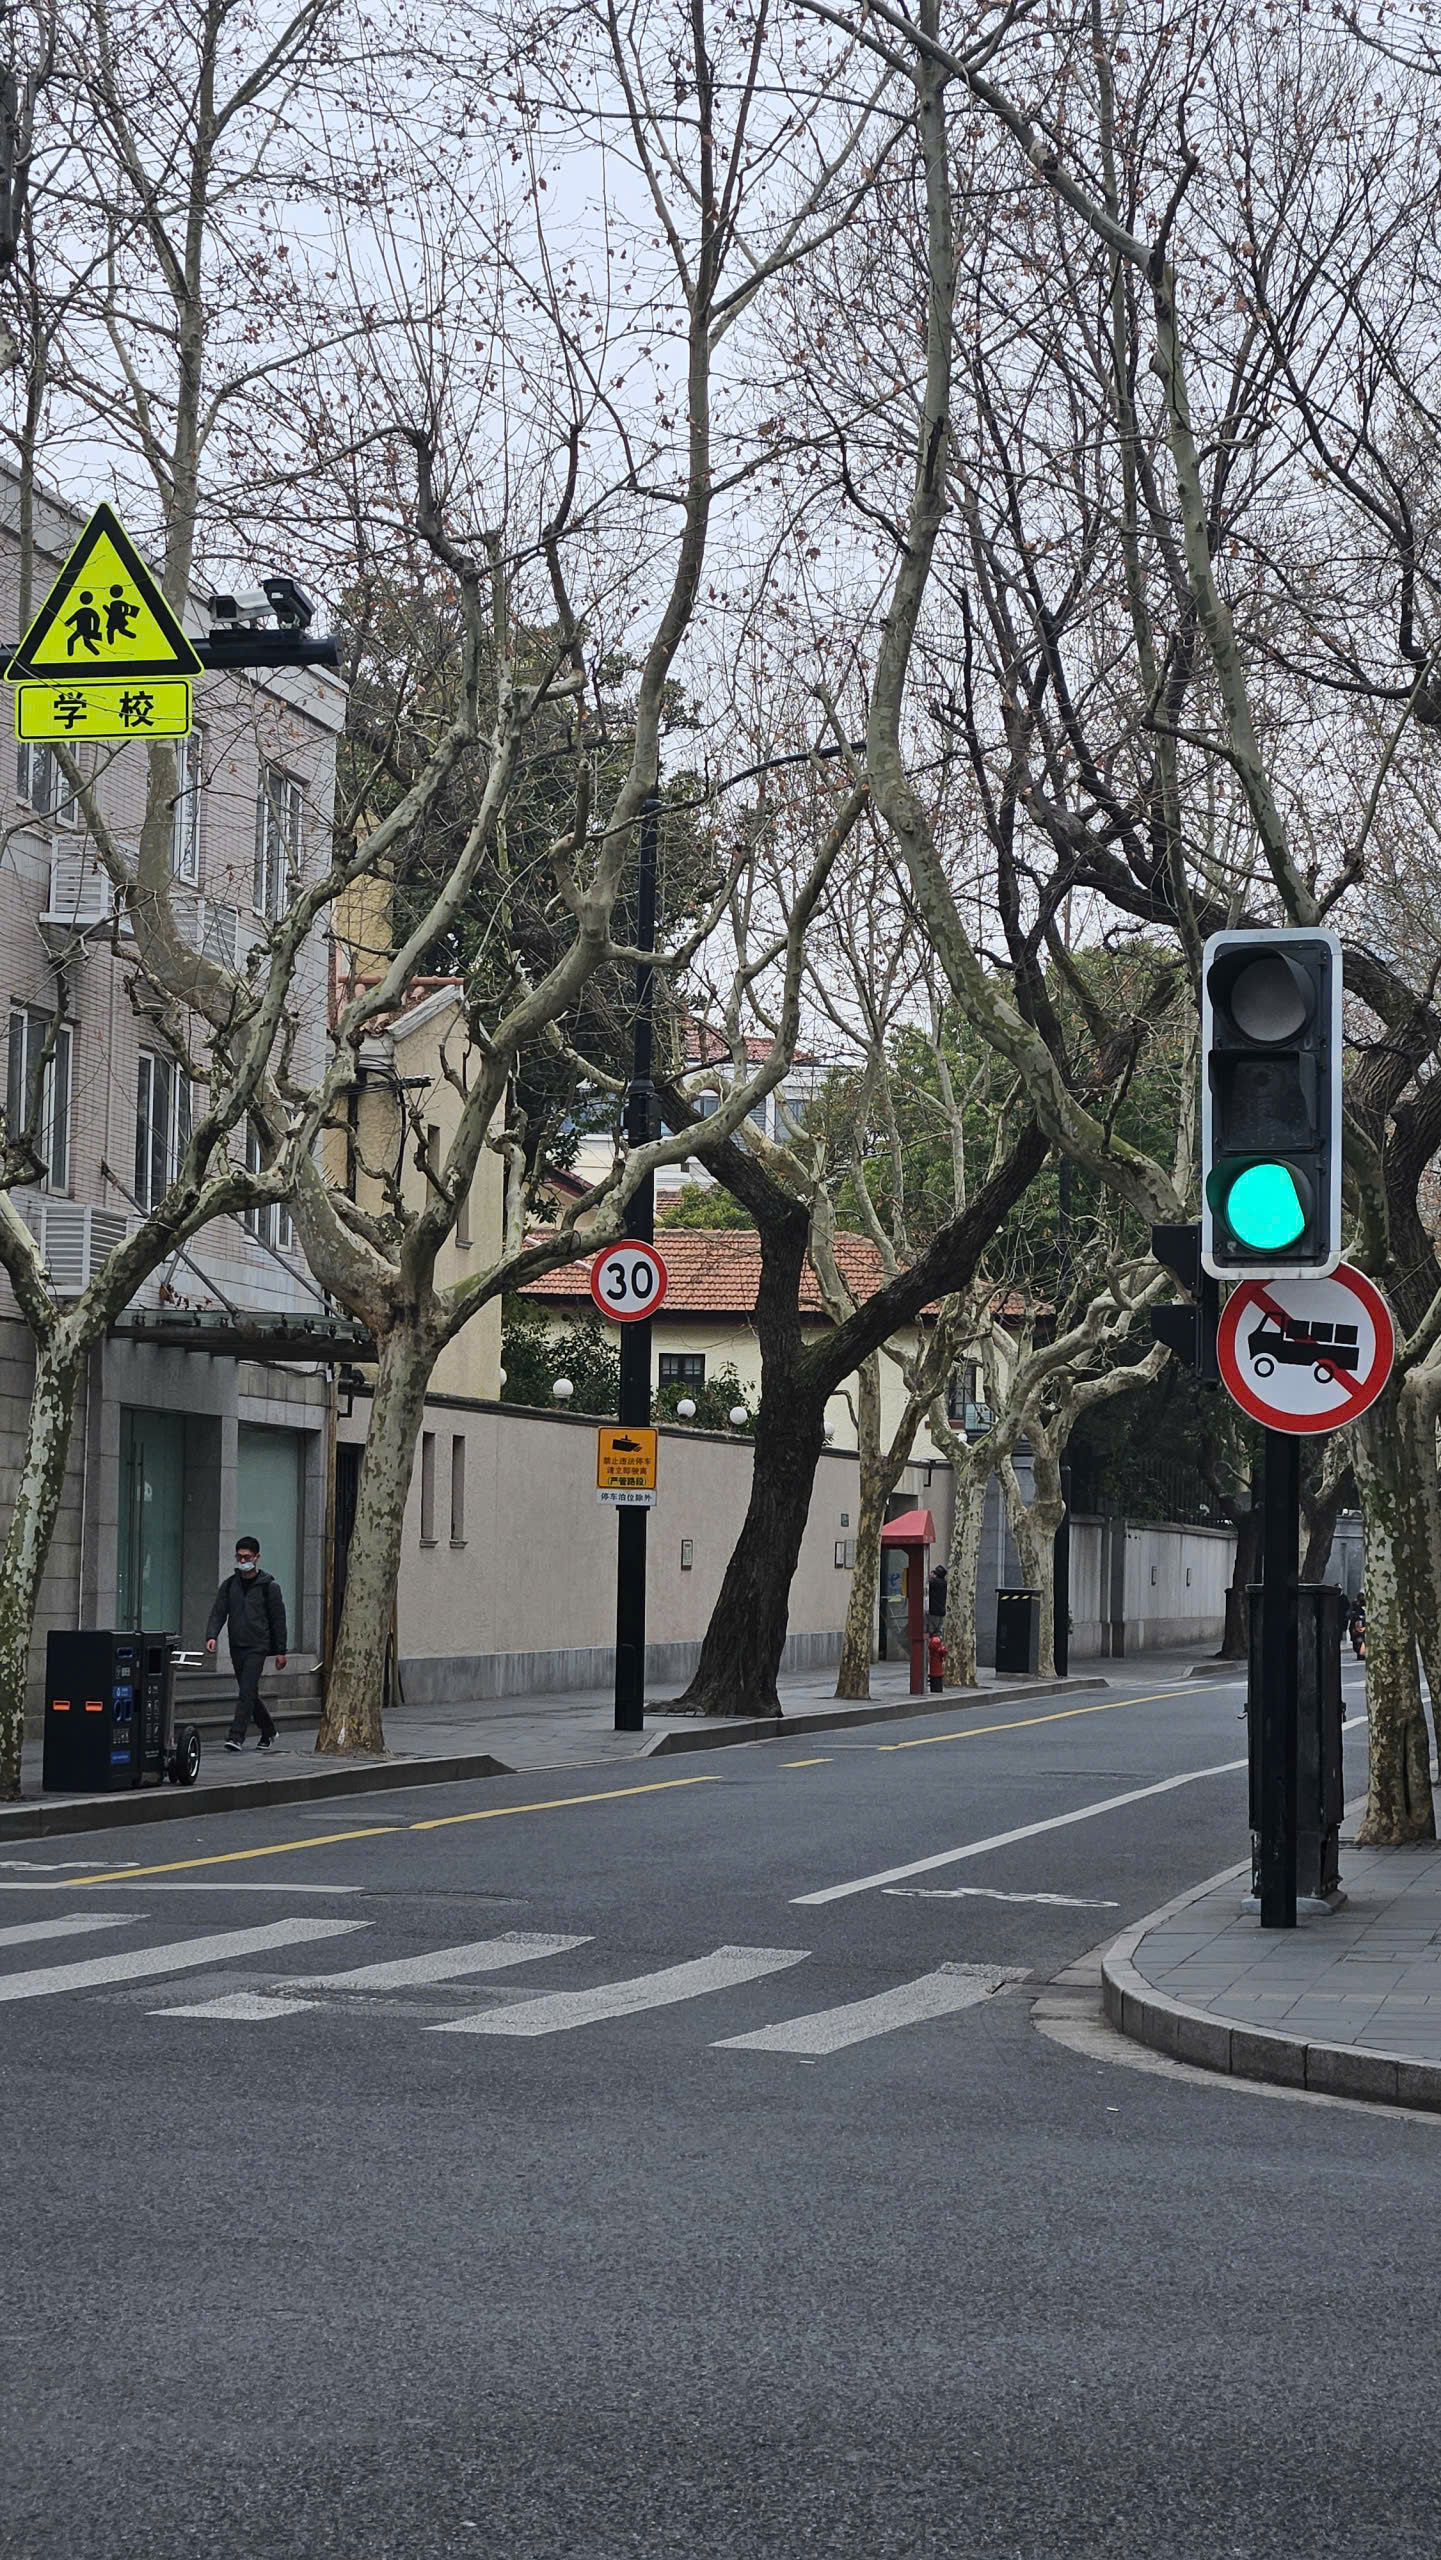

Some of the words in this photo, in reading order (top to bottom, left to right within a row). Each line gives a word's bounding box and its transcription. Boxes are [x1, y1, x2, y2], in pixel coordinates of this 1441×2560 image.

[53, 690, 155, 730] 学校
[606, 1260, 653, 1300] 30
[600, 1492, 652, 1502] 停车泊位除外
